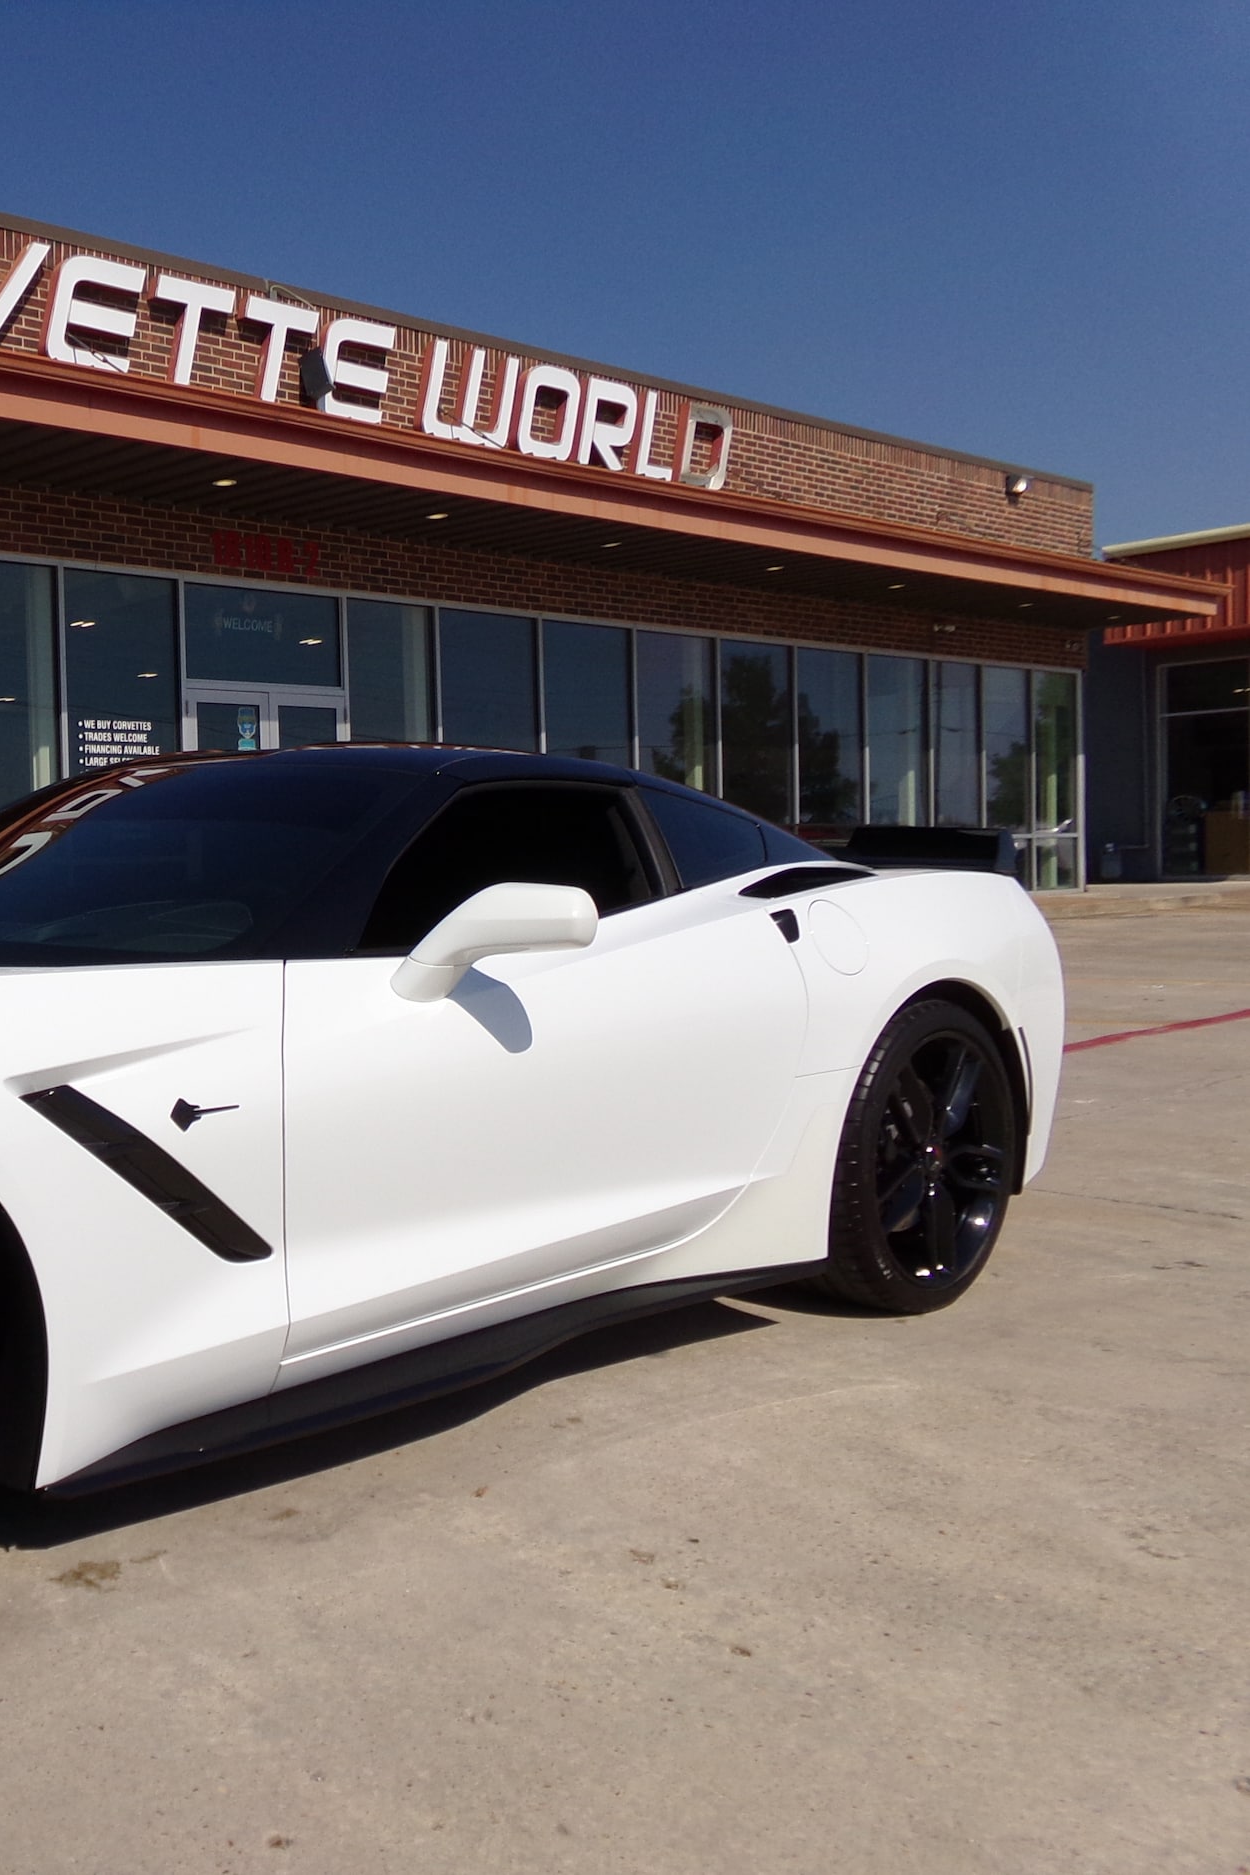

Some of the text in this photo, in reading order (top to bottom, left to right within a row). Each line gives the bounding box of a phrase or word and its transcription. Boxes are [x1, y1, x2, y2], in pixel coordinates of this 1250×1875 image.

[419, 339, 733, 491] WORLD
[223, 616, 273, 633] WELCOME
[84, 720, 152, 731] WE BUY CORVETTES
[84, 732, 148, 743] TRADES WELCOME
[85, 744, 160, 755] FINANCING AVAILABLE
[85, 757, 108, 766] LARGE
